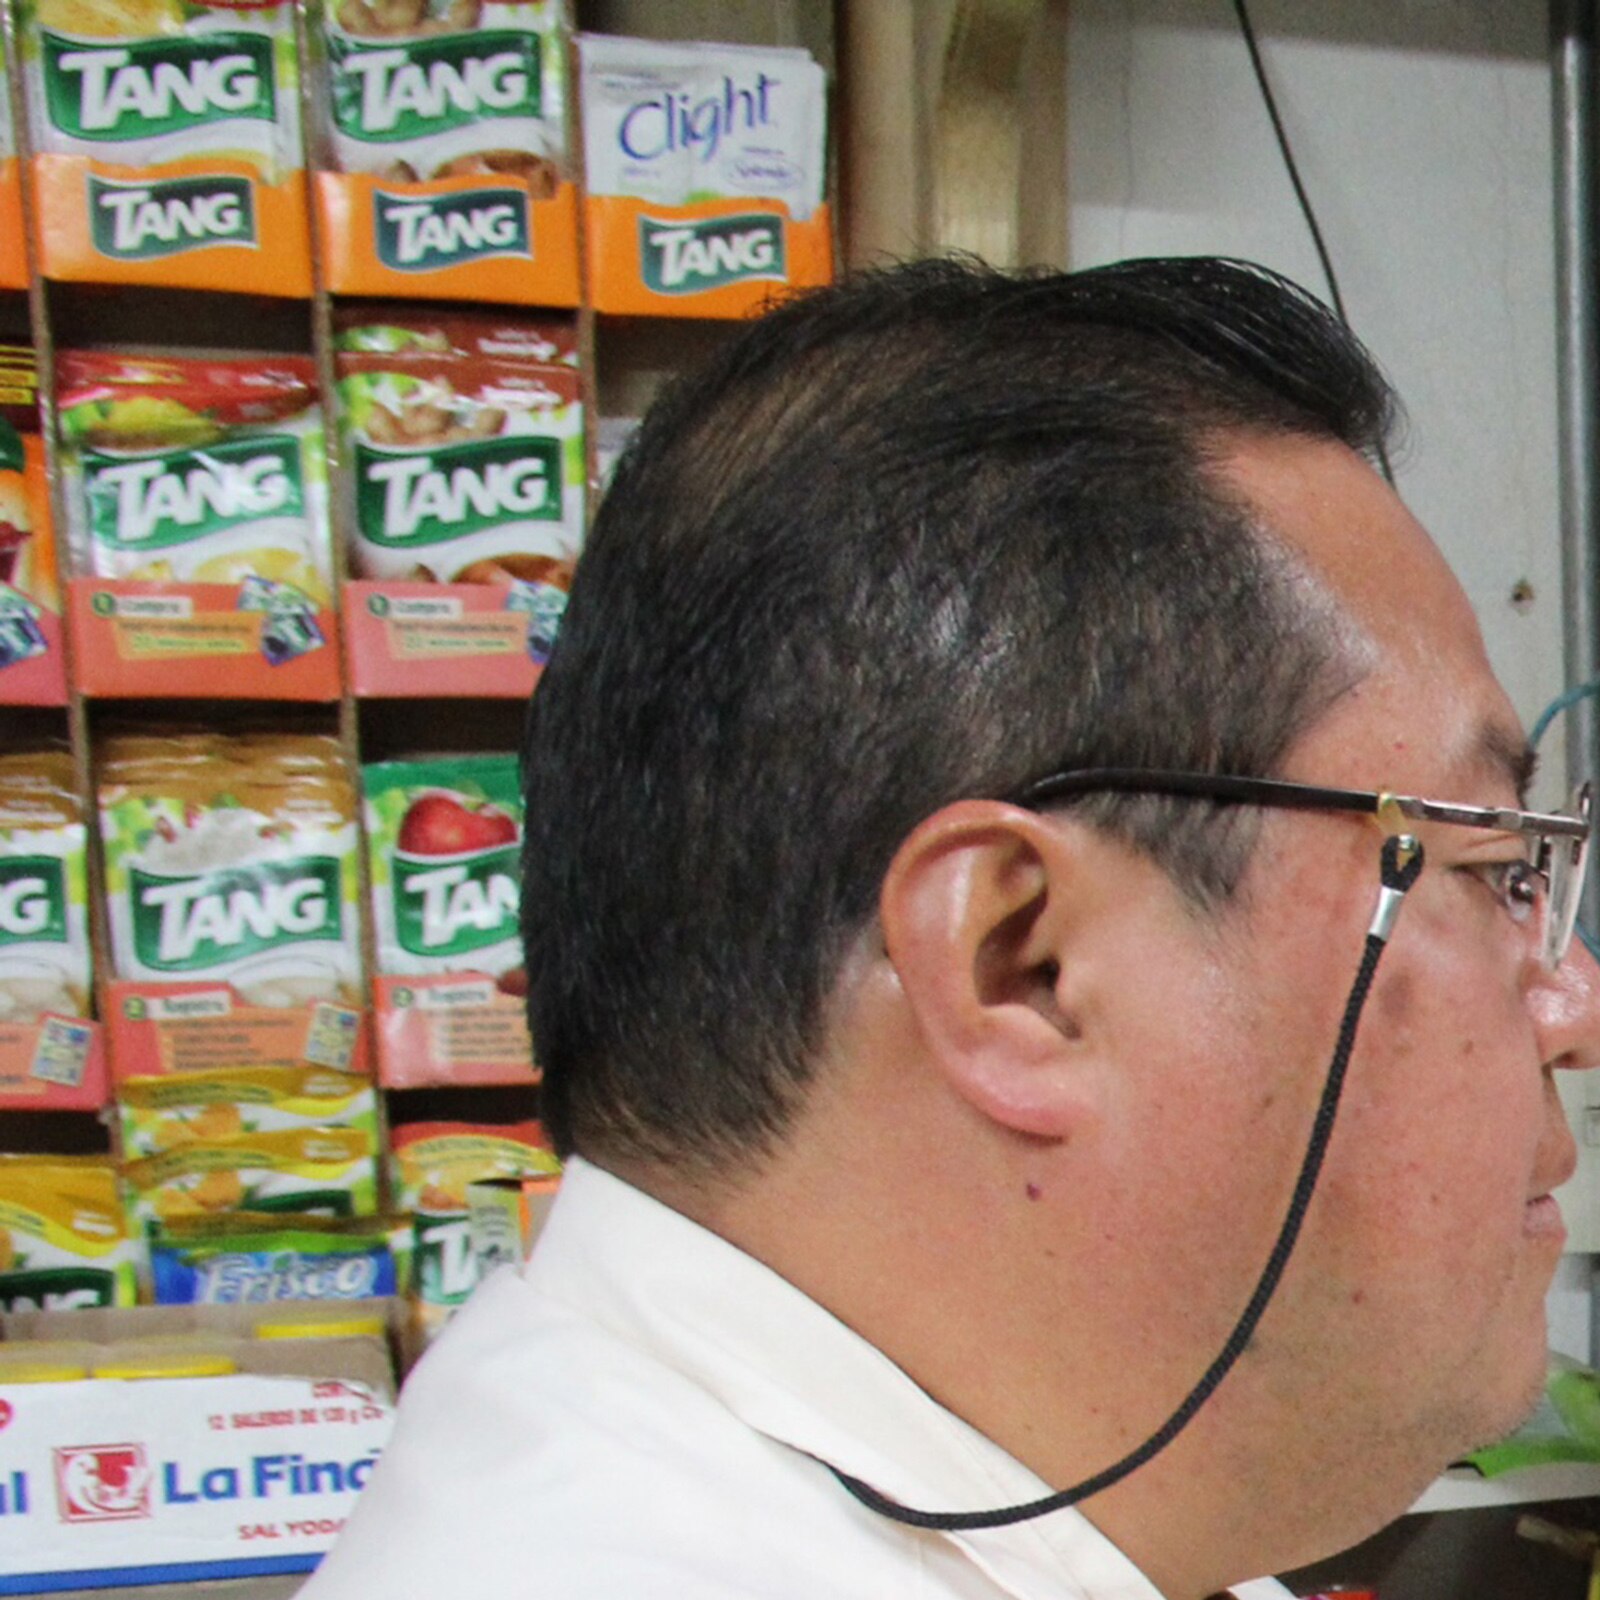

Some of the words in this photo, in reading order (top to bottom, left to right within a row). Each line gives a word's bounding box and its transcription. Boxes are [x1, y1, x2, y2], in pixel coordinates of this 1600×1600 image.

[60, 49, 264, 130] TANG
[337, 50, 531, 132] TANG
[620, 74, 779, 162] Clight
[100, 186, 243, 250] TANG
[385, 202, 518, 262] TANG
[650, 230, 774, 284] TANG
[102, 457, 290, 538] TANG
[369, 457, 550, 538] TANG
[141, 877, 329, 961] TANG
[163, 1462, 239, 1504] La
[238, 1519, 280, 1541] SAL
[286, 1516, 346, 1538] YOD
